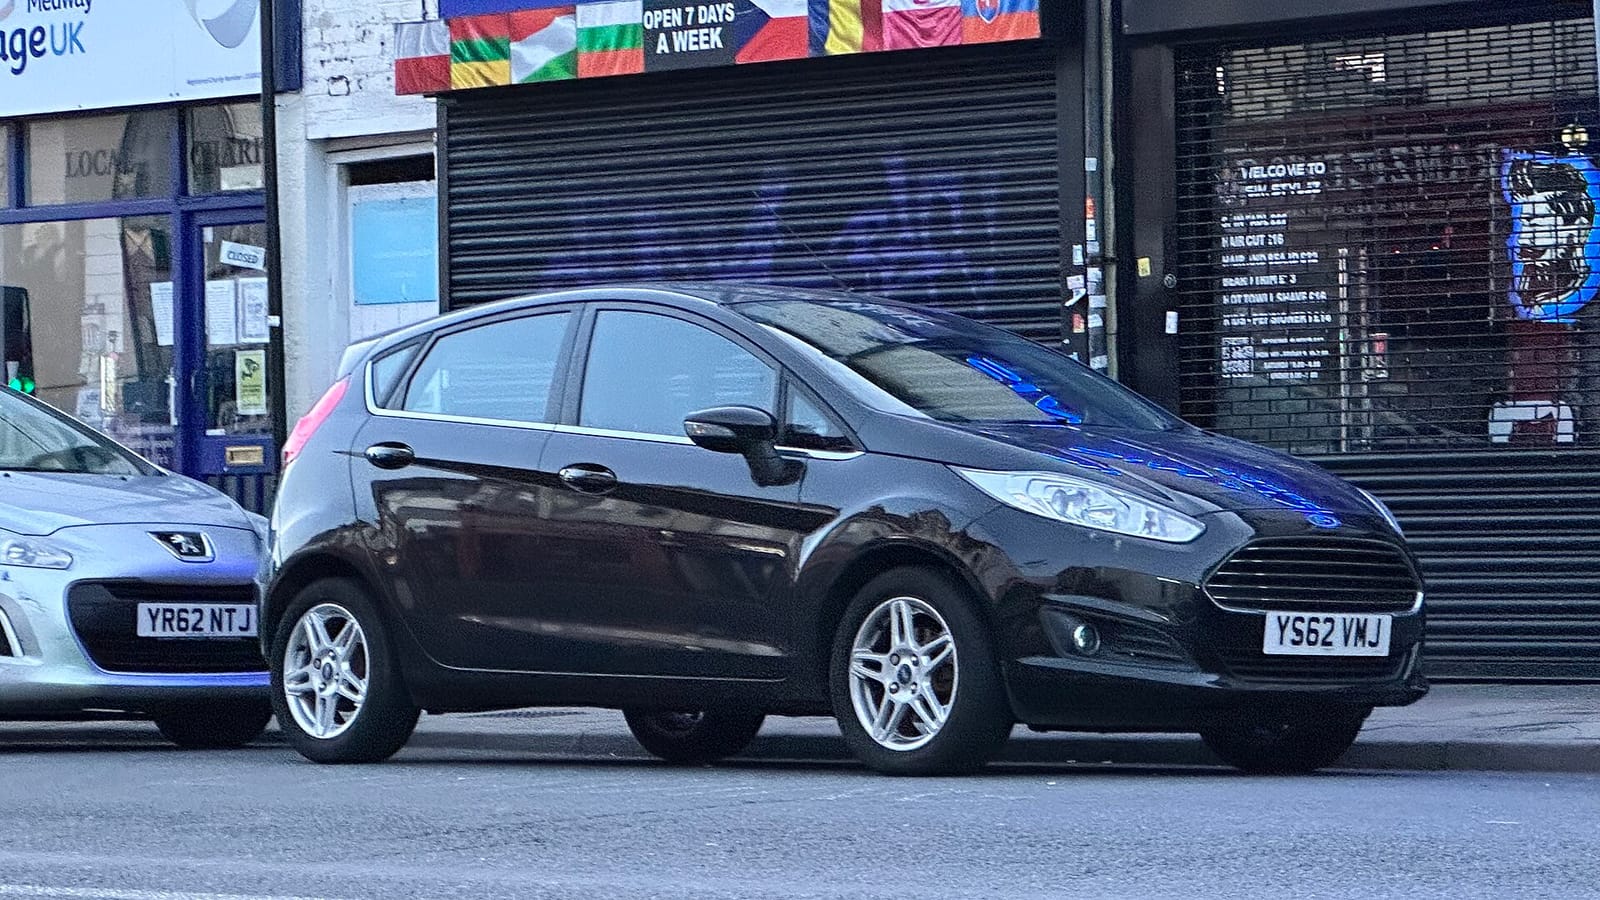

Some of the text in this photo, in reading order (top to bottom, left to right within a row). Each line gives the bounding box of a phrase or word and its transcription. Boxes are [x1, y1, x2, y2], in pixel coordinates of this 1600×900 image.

[643, 3, 735, 30] OPEN 7 DAYS
[50, 21, 86, 56] UK
[656, 27, 723, 54] A WEEK
[1307, 162, 1326, 176] TO
[1246, 234, 1266, 247] CUT
[147, 607, 251, 632] YR62 NTJ
[1277, 615, 1382, 648] YS62 VMJ
